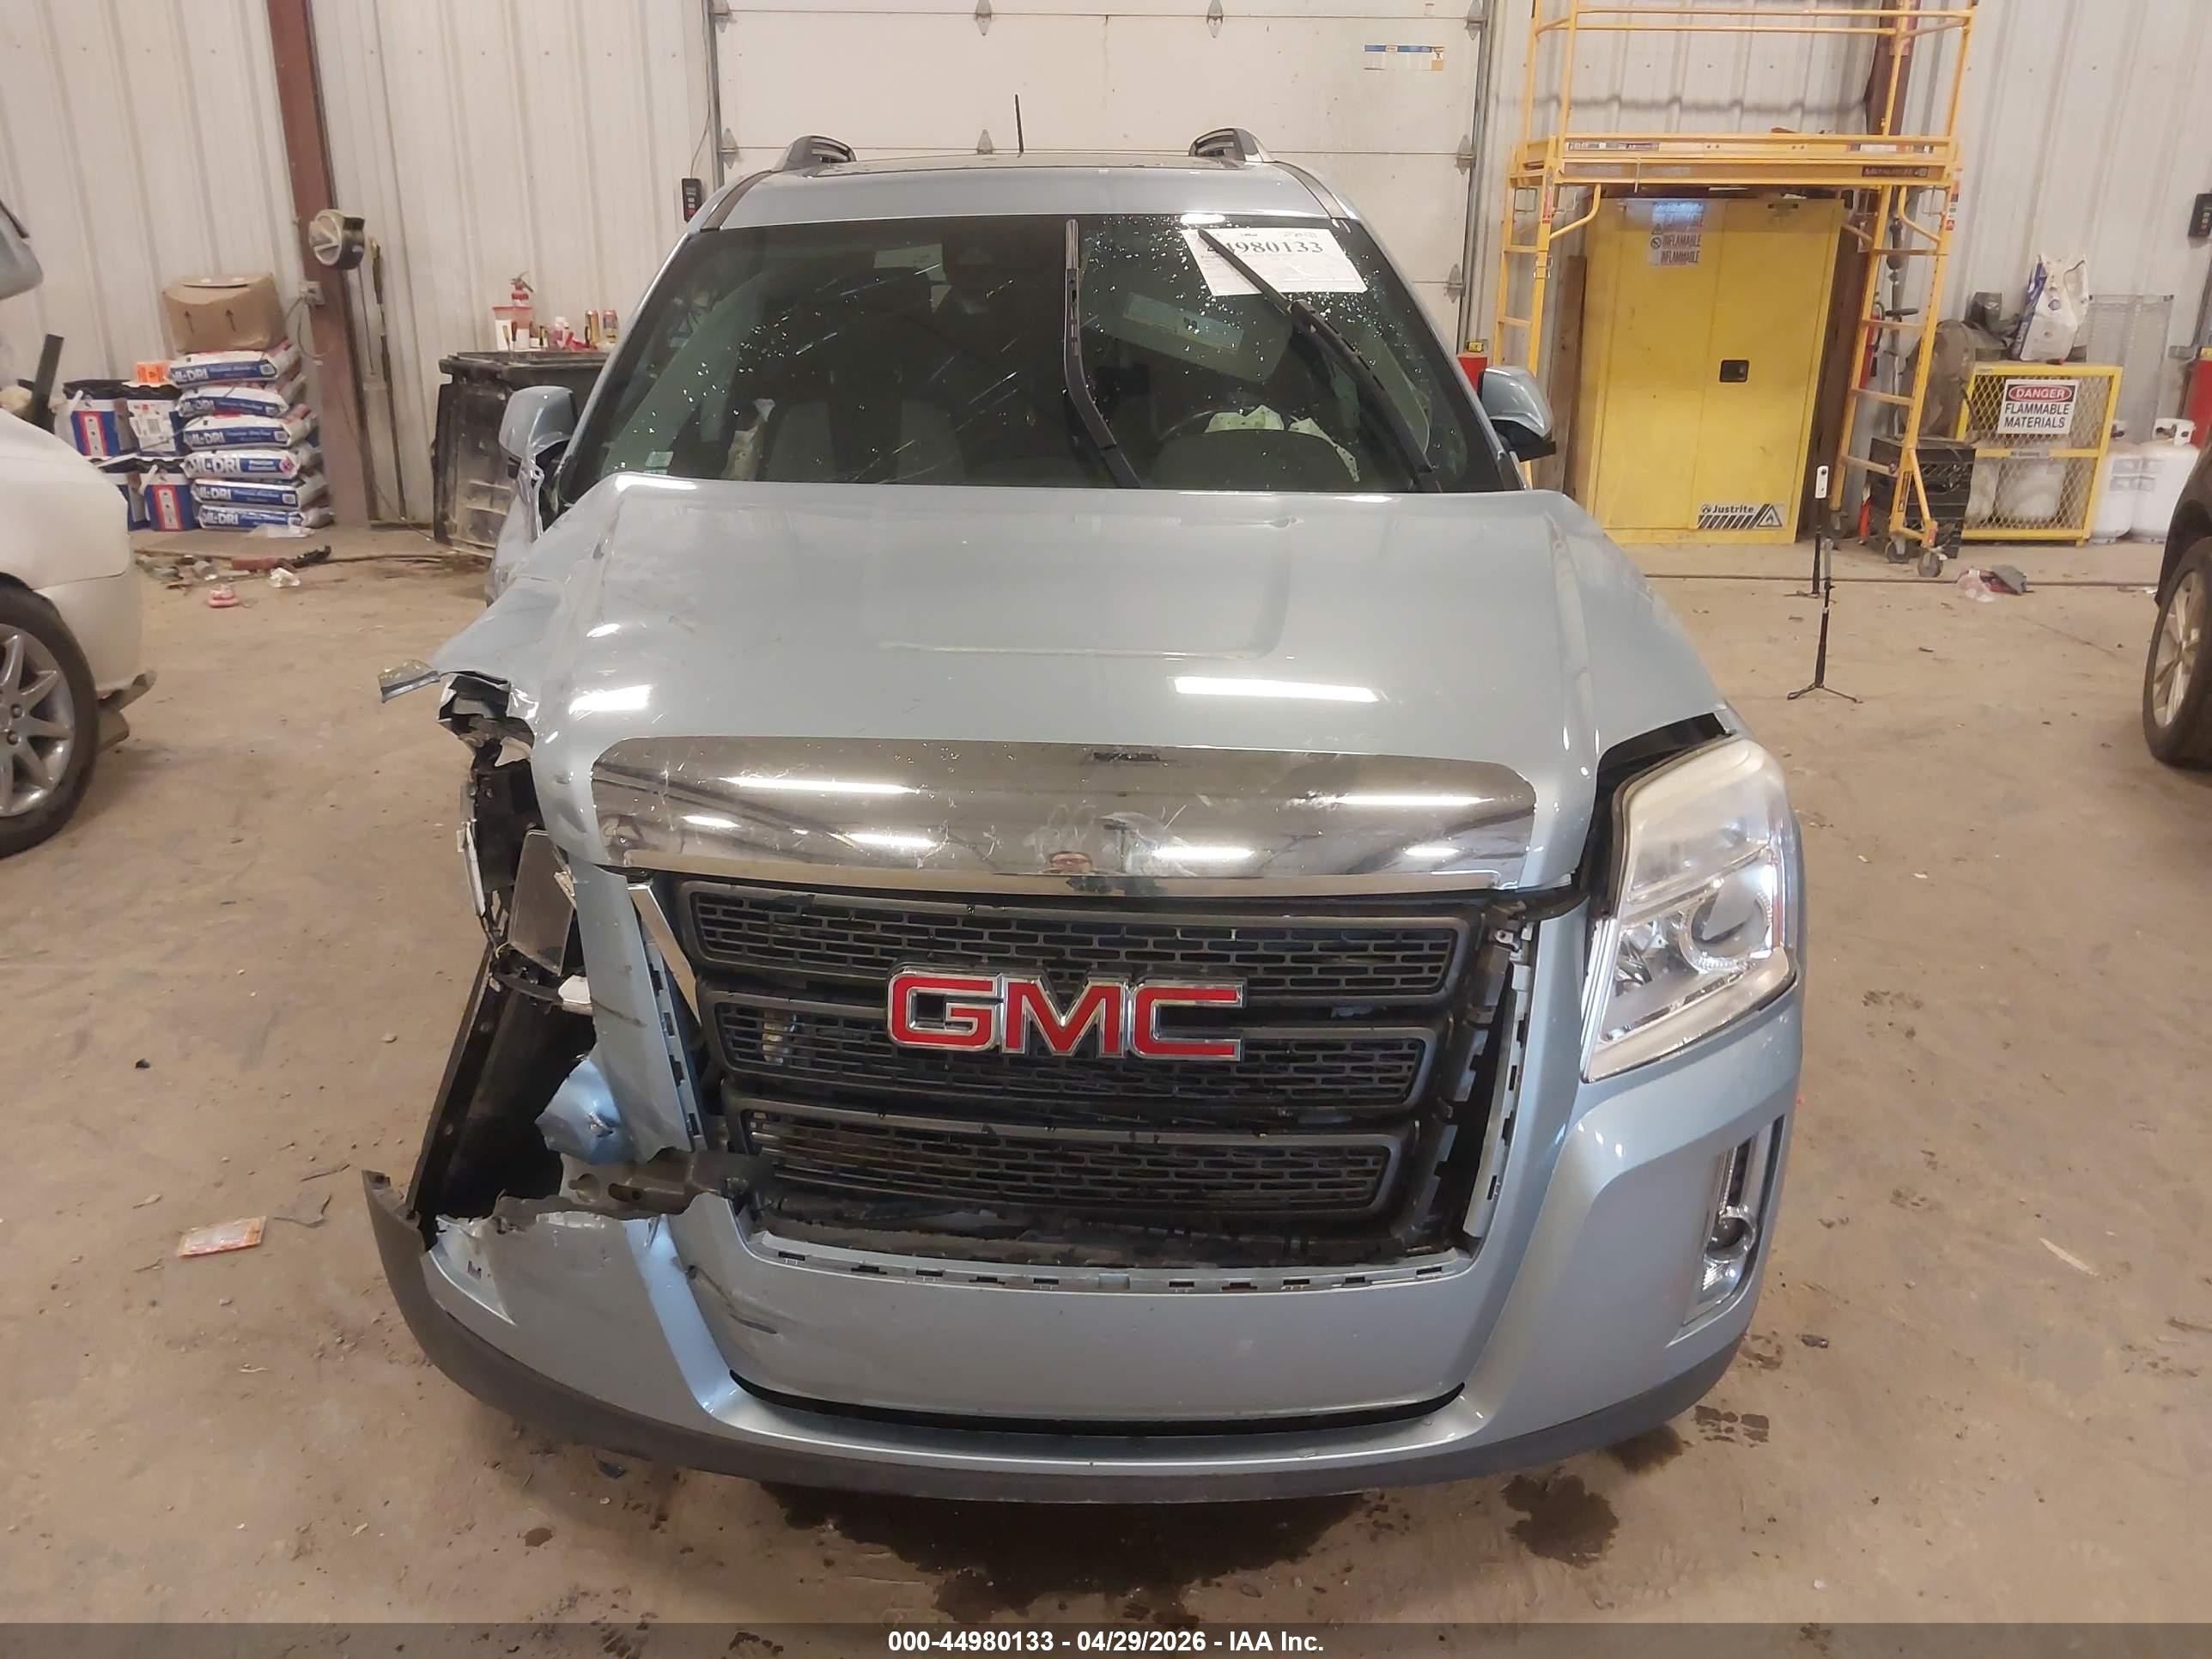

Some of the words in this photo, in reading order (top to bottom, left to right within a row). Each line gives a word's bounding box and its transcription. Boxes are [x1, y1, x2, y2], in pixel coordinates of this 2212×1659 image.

[2015, 388, 2065, 398] DANGER
[2004, 403, 2070, 415] FLAMMABLE
[2004, 416, 2065, 428] MATERIALS
[1712, 504, 1754, 514] Justrite
[888, 972, 1242, 1061] GMC
